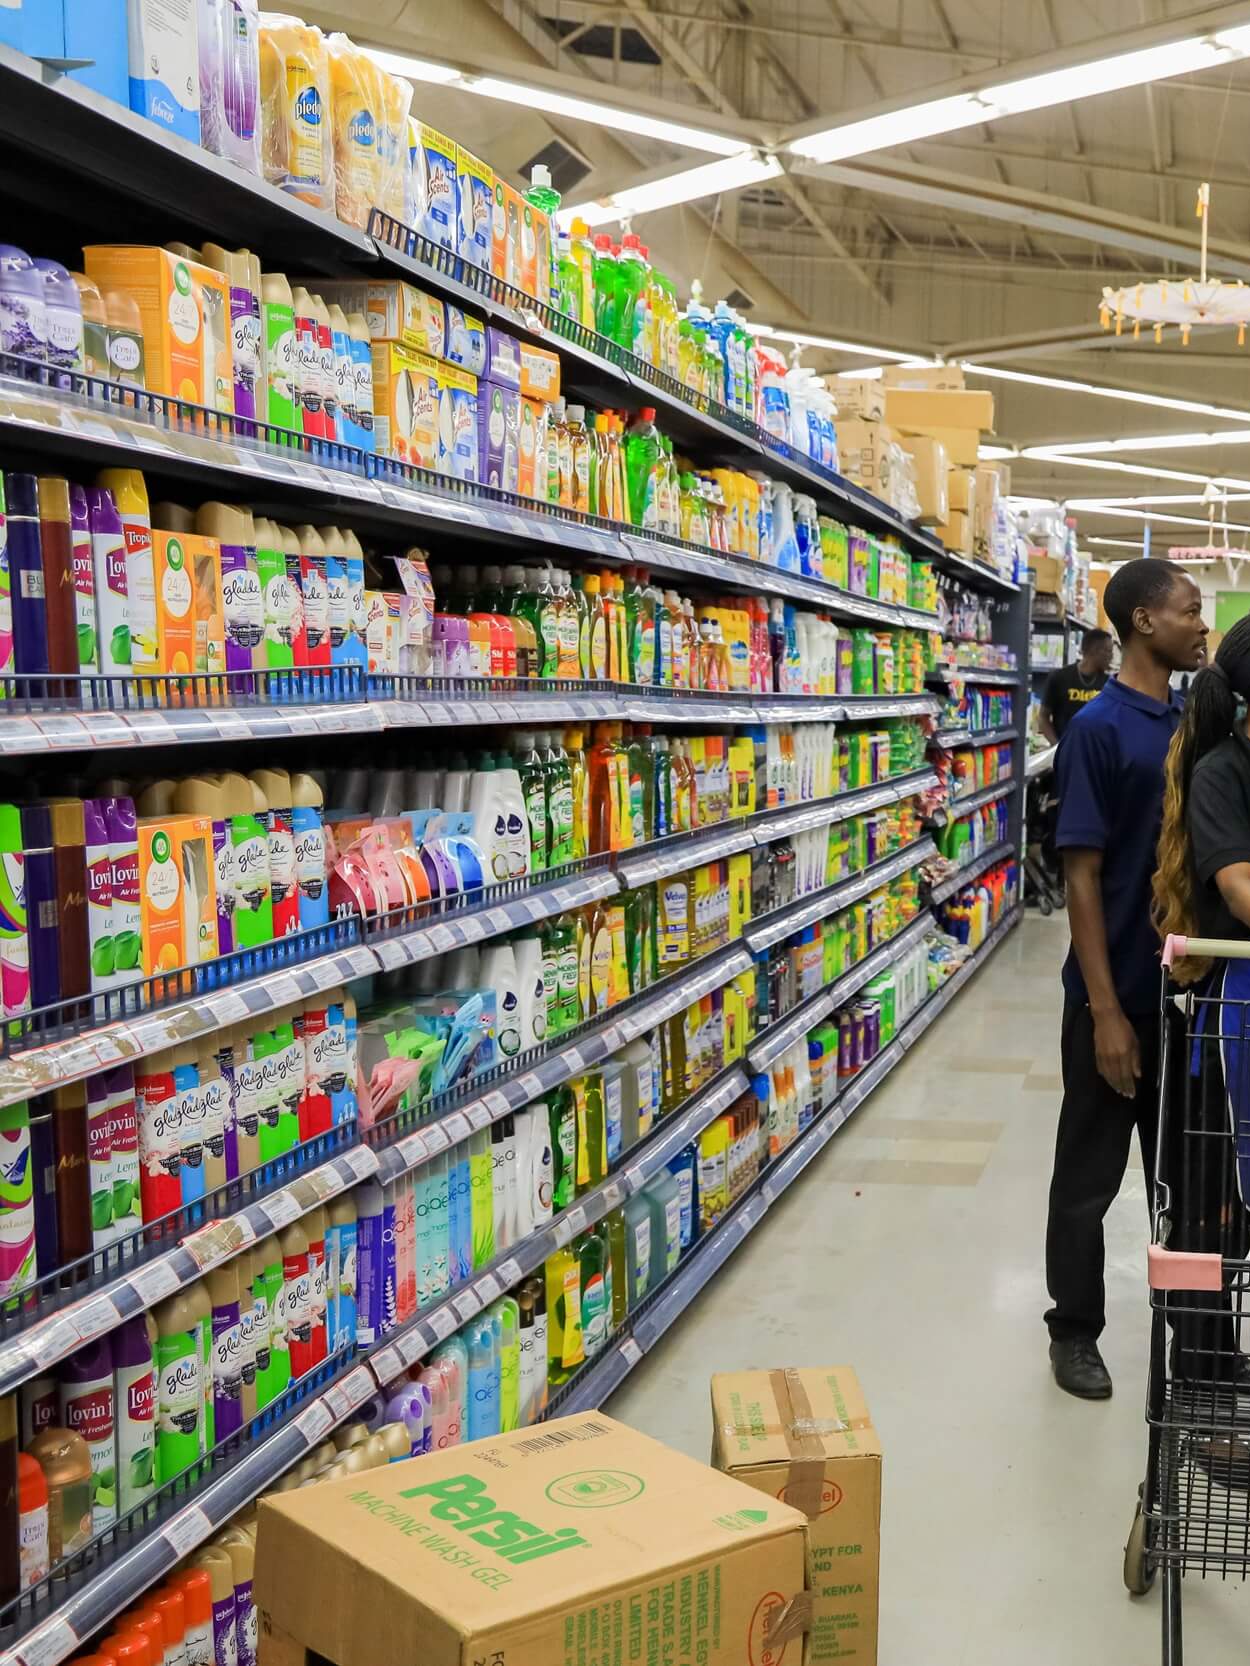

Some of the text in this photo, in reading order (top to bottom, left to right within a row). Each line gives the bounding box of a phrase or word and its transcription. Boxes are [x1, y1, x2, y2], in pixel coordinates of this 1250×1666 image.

[131, 1381, 154, 1409] Lovi
[349, 1490, 514, 1592] MACHINE WASH GEL
[399, 1474, 588, 1565] Persil
[837, 1544, 863, 1556] FOR
[646, 1588, 659, 1623] FOR
[662, 1581, 675, 1638] TRADE
[679, 1575, 692, 1657] INDUSTRY
[696, 1569, 709, 1636] HENKEL
[822, 1583, 864, 1596] KENYA
[628, 1594, 641, 1660] LIMITED
